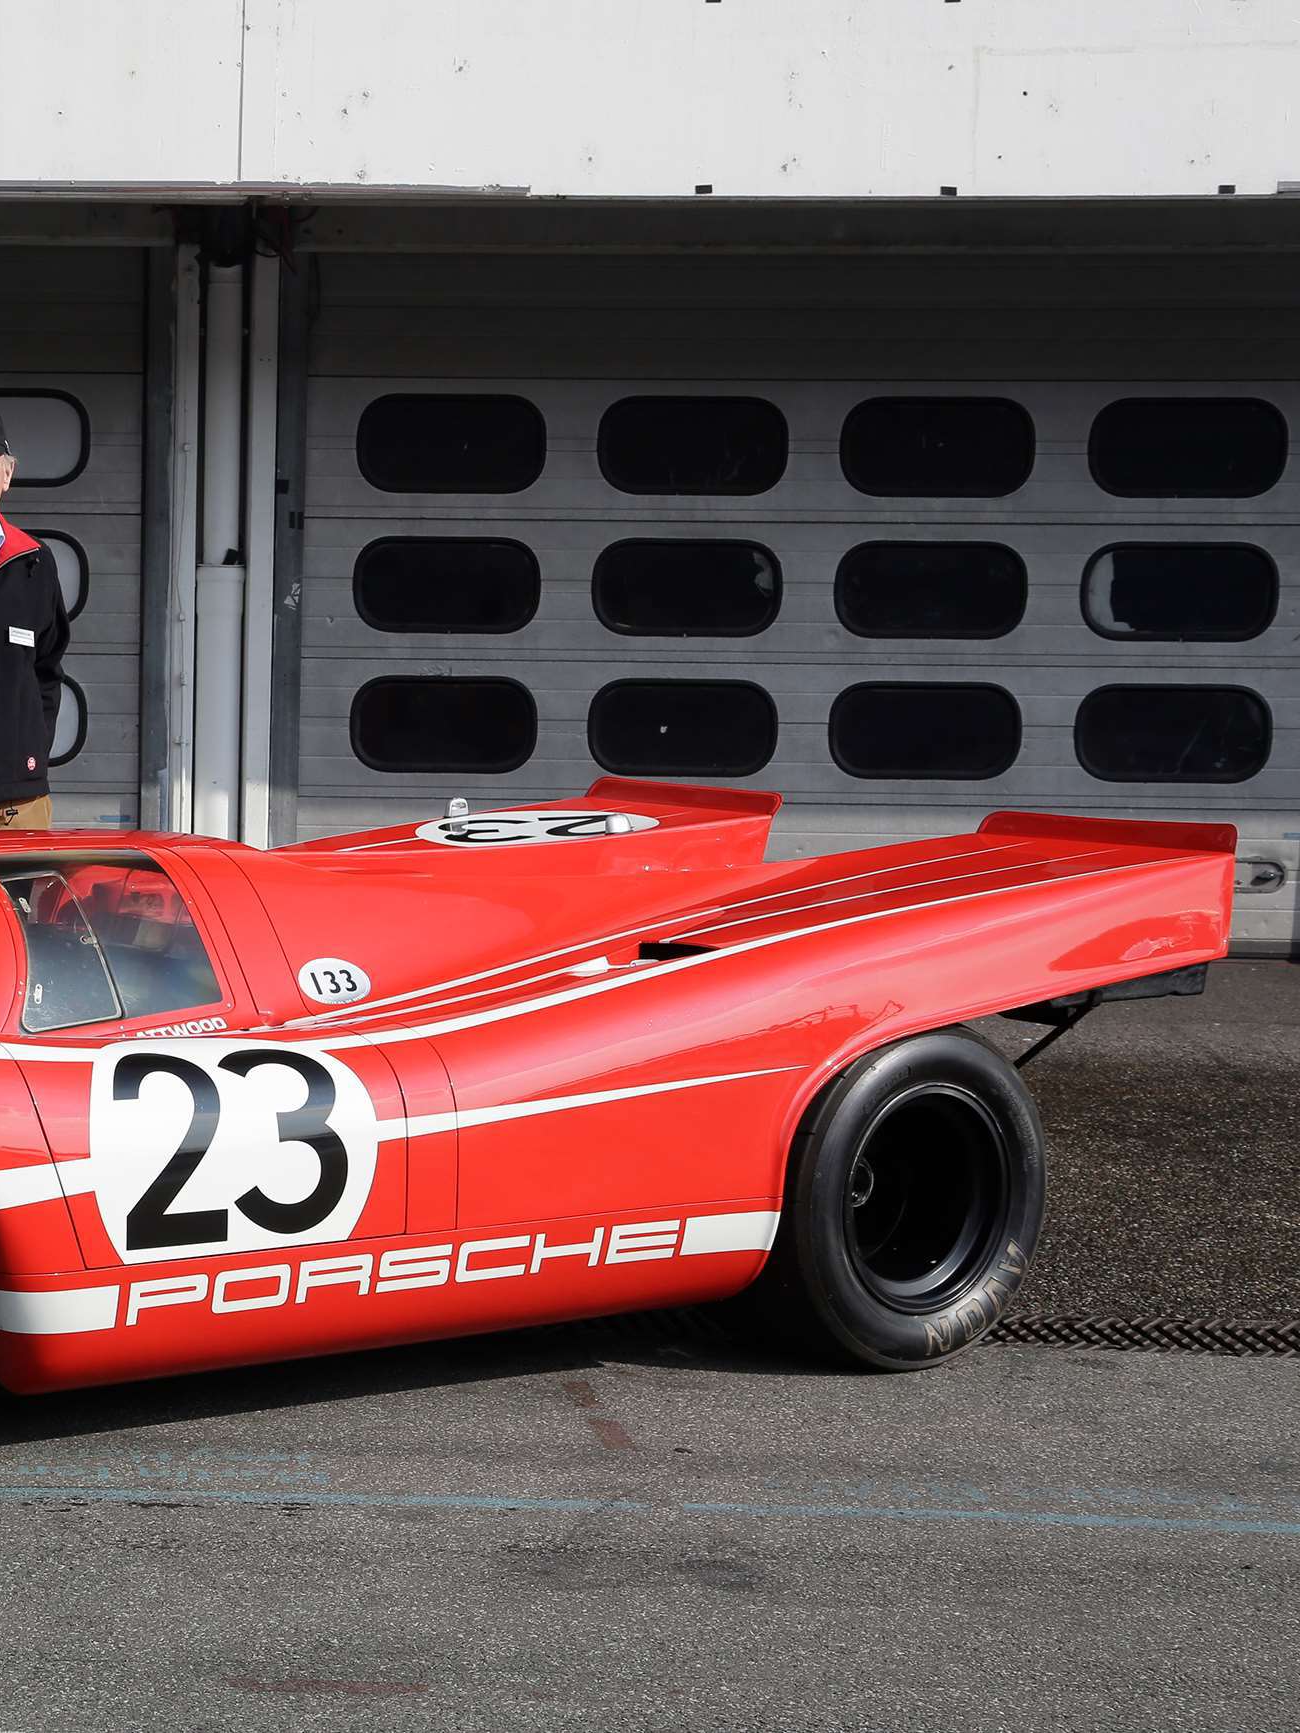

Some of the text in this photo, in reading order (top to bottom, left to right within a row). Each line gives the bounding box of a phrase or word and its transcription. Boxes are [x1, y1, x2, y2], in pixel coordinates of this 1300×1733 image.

[310, 969, 358, 995] 133
[112, 1051, 349, 1251] 23
[125, 1218, 681, 1327] PORSCHE
[922, 1238, 1029, 1357] AVON
